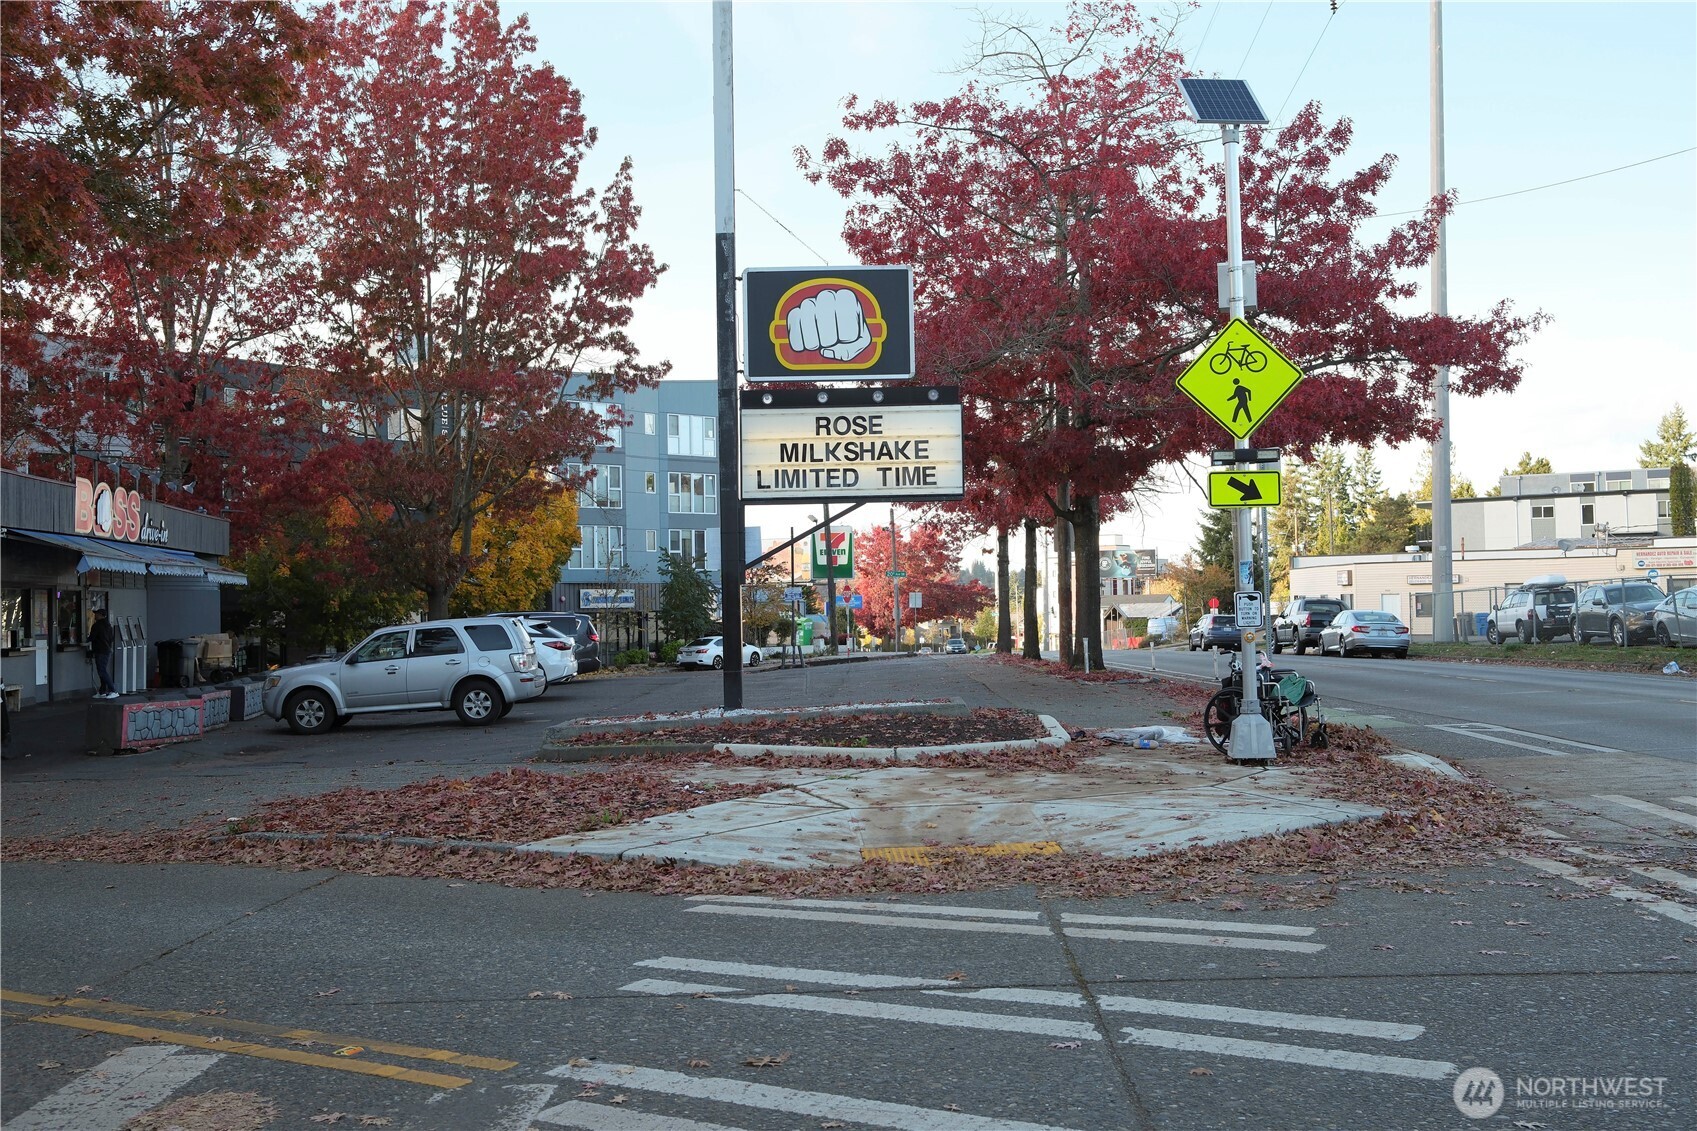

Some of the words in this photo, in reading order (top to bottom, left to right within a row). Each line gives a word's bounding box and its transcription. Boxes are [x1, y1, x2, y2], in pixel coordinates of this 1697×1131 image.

[815, 415, 884, 437] ROSE
[780, 439, 930, 464] MILKSHAKE
[756, 468, 860, 490] LIMITED
[876, 466, 938, 487] TIME
[75, 476, 141, 543] BOSS
[140, 512, 169, 545] drive-in
